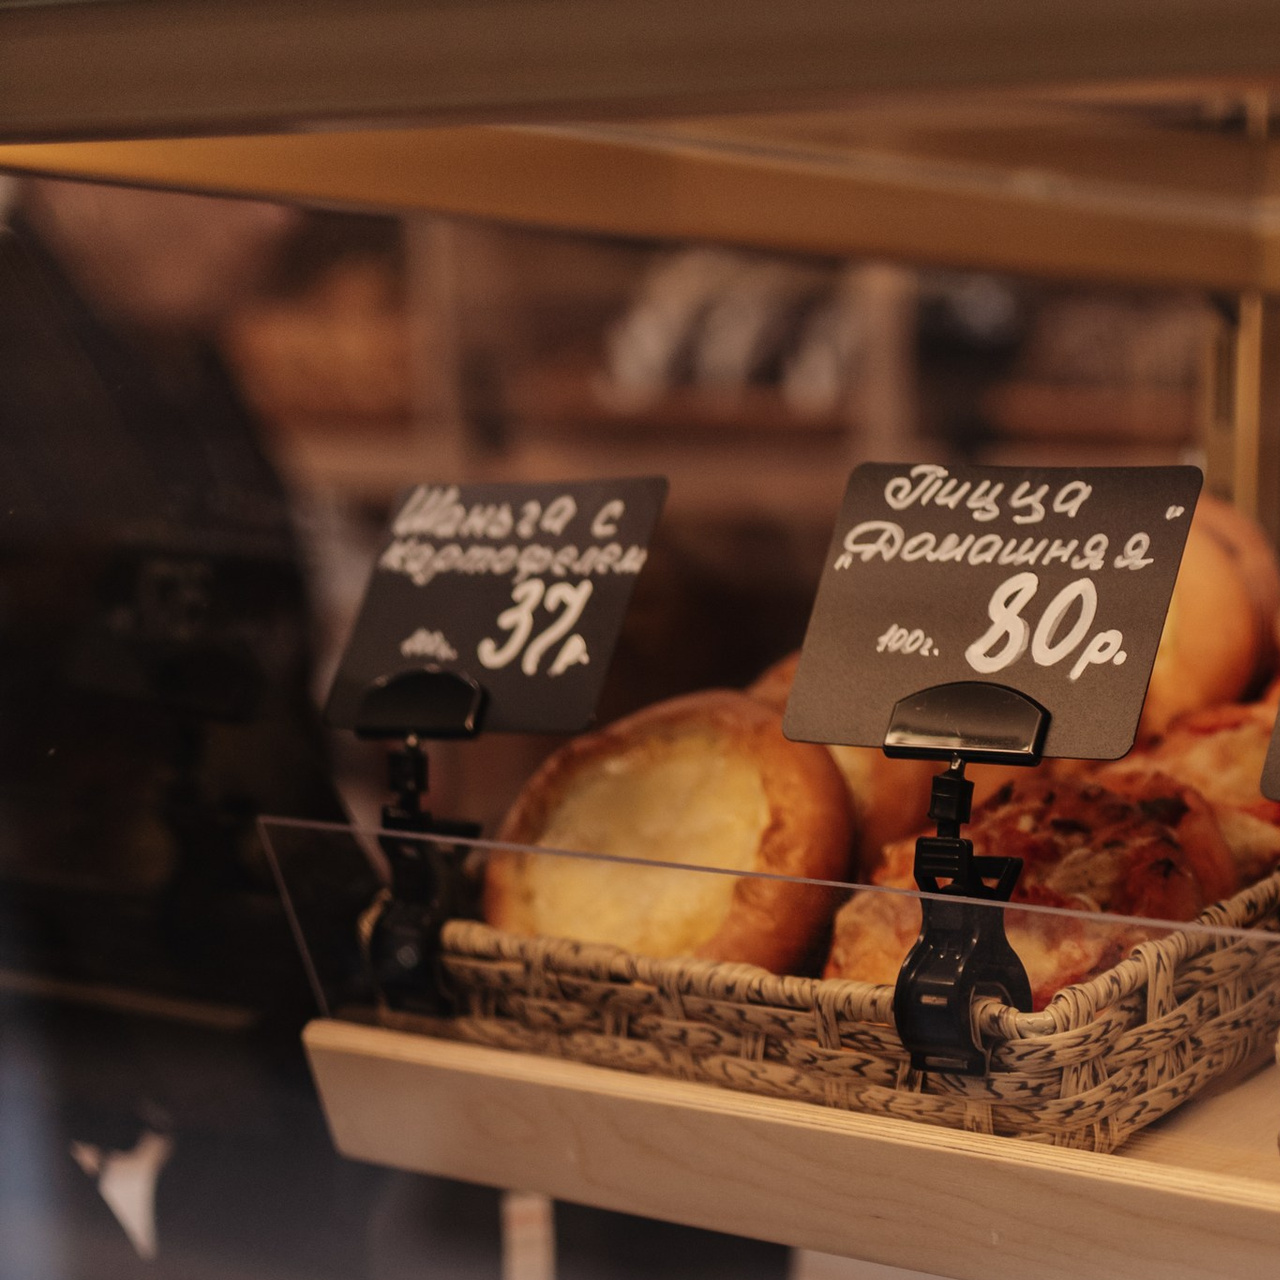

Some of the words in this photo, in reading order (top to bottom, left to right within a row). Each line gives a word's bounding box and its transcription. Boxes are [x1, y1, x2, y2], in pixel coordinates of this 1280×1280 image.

[592, 500, 625, 538] с
[883, 463, 1093, 525] Пицца
[964, 571, 1128, 682] 80р.
